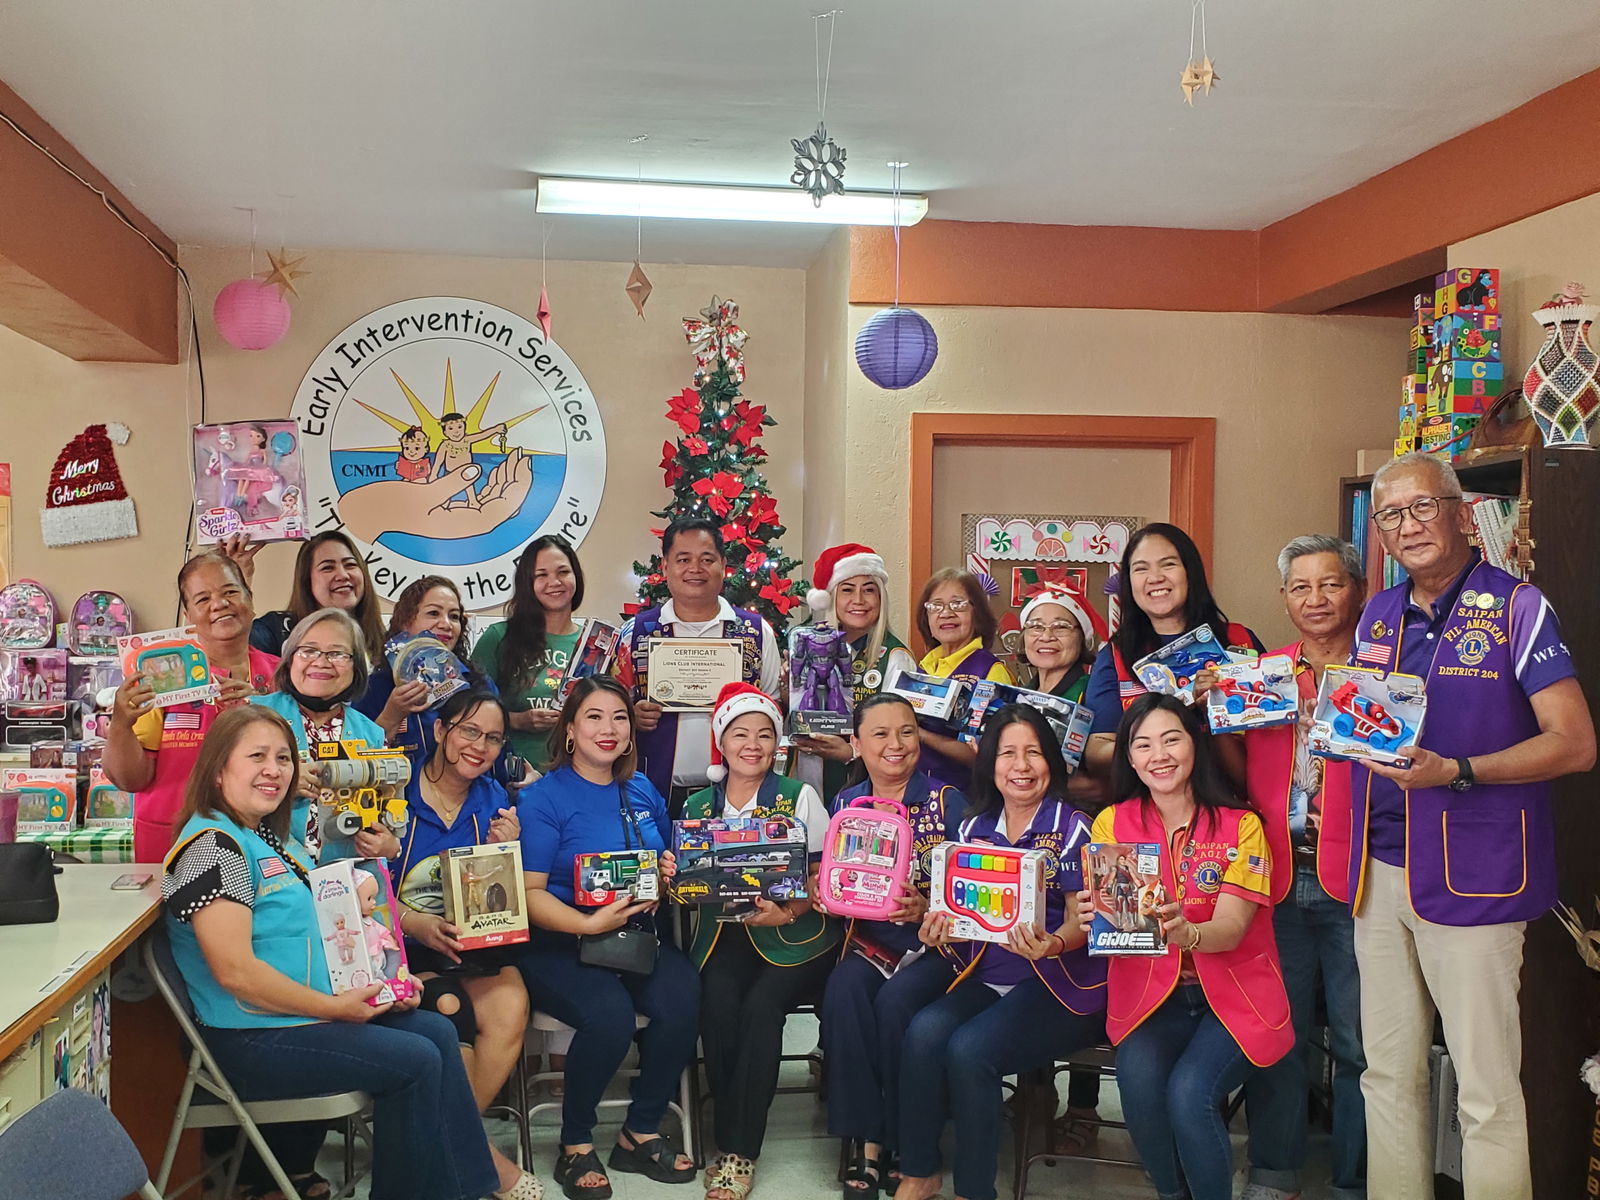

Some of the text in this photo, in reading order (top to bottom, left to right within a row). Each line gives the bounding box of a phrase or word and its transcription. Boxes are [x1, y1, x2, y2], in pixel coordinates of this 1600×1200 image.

[1458, 268, 1472, 284] G
[1442, 302, 1448, 315] G
[1484, 315, 1497, 330] F
[303, 308, 593, 444] Early Intervention Services
[1472, 362, 1486, 378] C
[1472, 379, 1486, 395] B
[1472, 397, 1485, 410] A
[60, 458, 99, 480] Merry
[342, 464, 388, 478] CNMI
[52, 480, 116, 506] Christmas
[199, 510, 237, 530] Sparkle
[1457, 607, 1504, 619] SAIPAN
[1532, 645, 1558, 664] WE
[1438, 666, 1500, 680] DISTRICT 204
[740, 832, 746, 840] 7
[1060, 862, 1078, 872] WE
[1204, 870, 1216, 883] L
[471, 918, 515, 930] AVATAR
